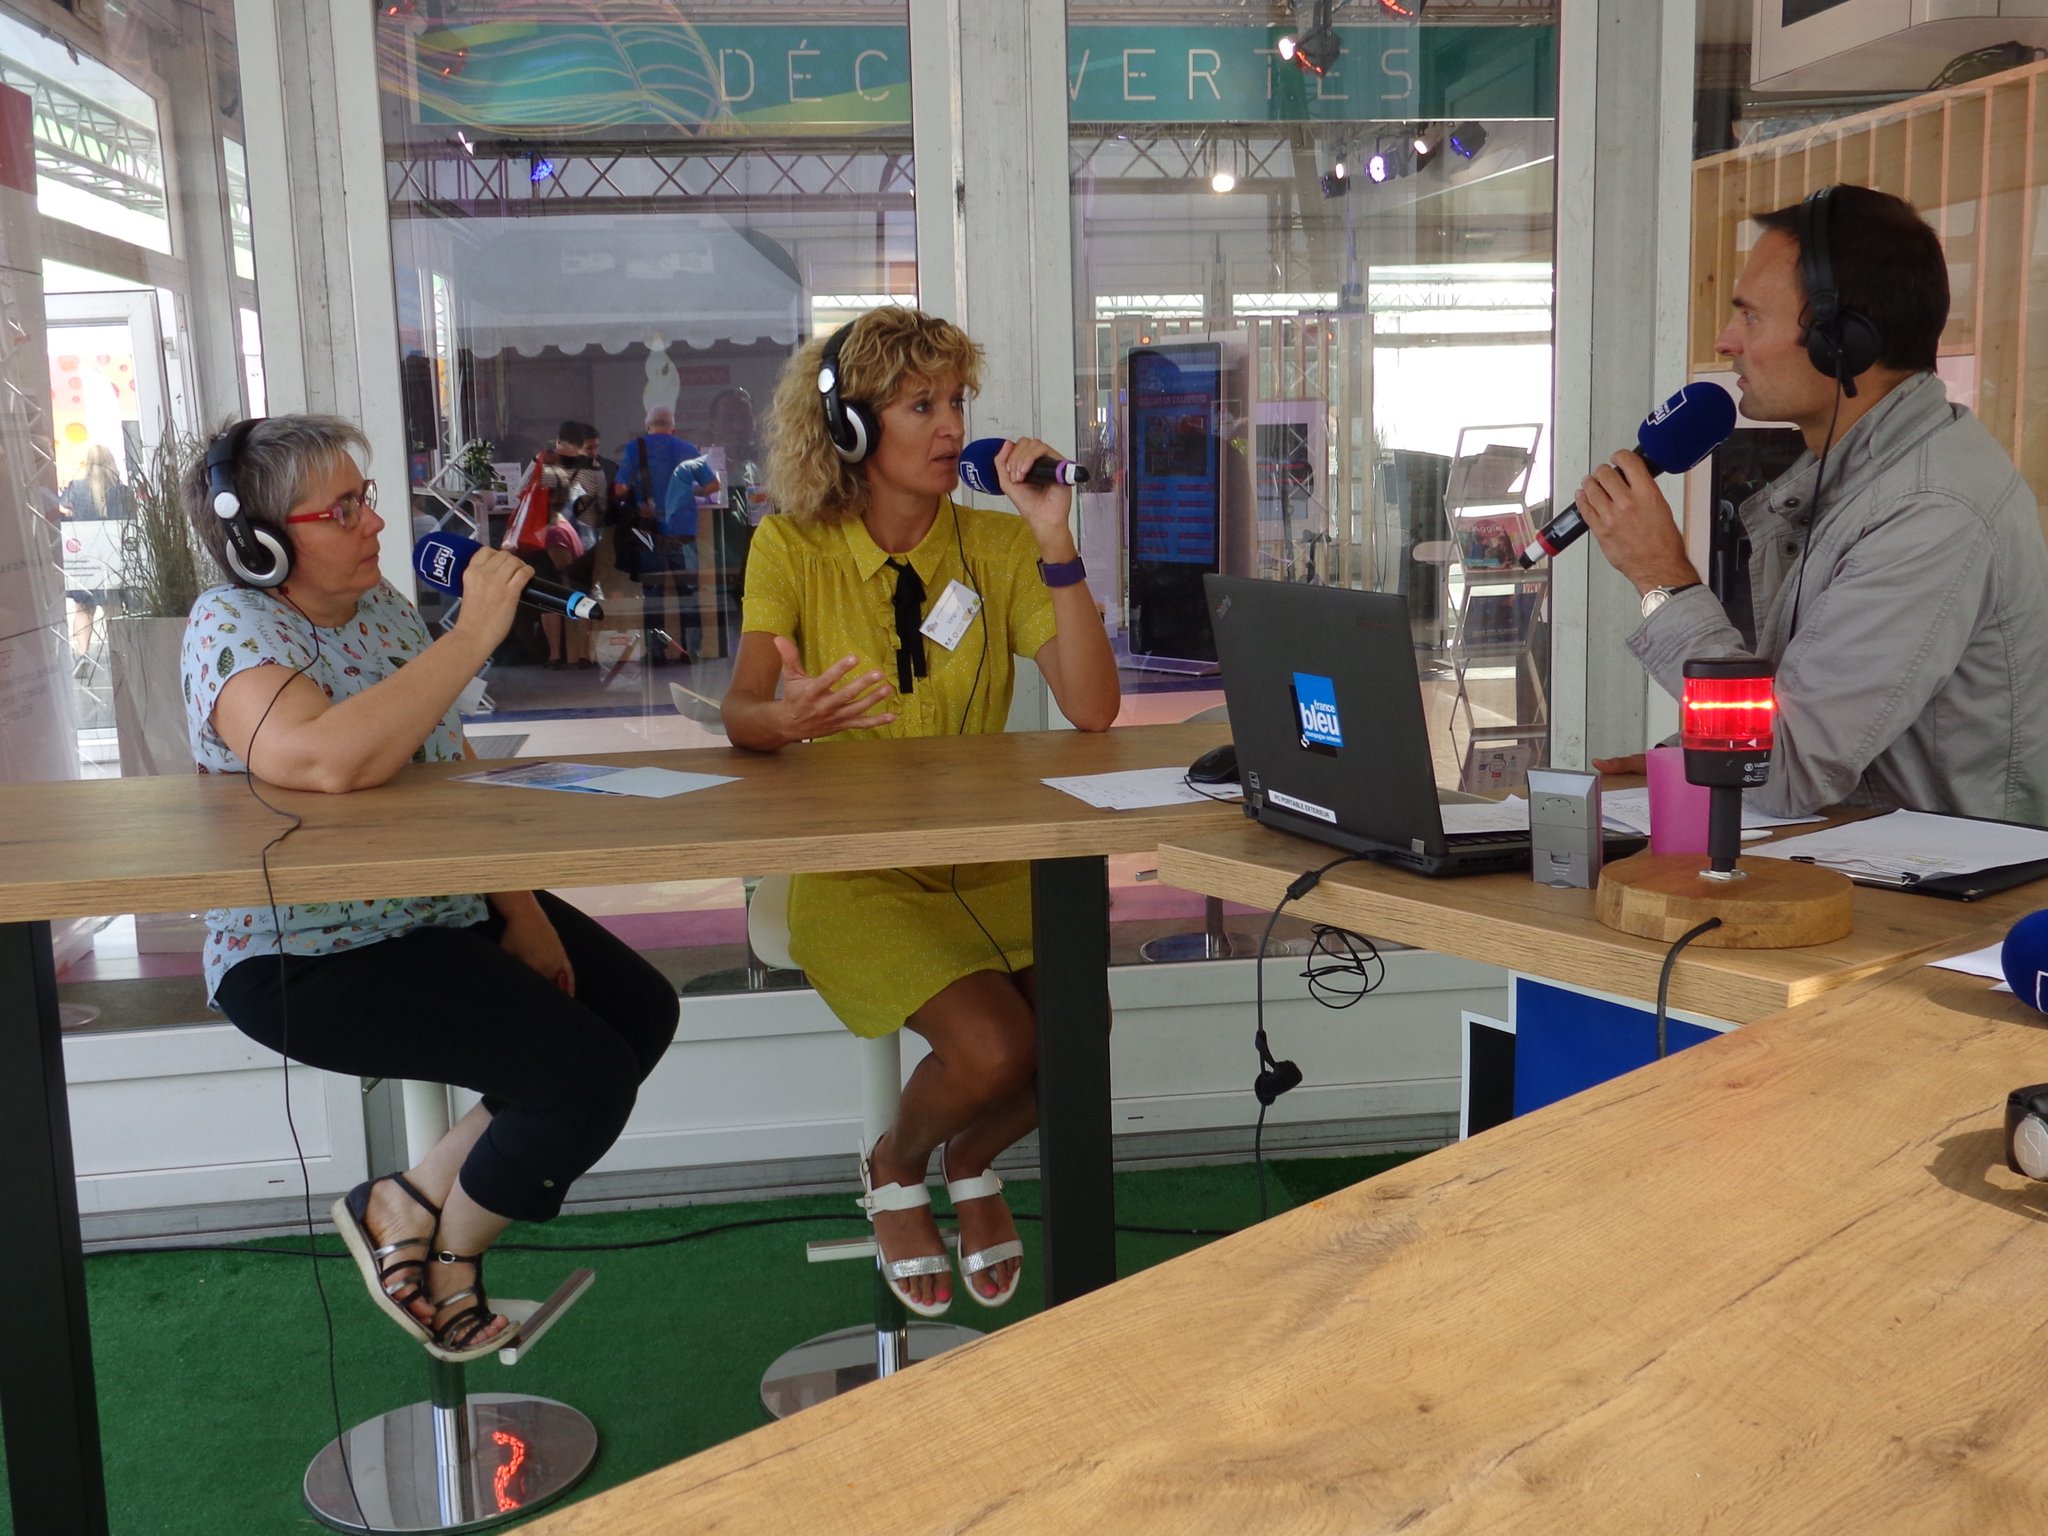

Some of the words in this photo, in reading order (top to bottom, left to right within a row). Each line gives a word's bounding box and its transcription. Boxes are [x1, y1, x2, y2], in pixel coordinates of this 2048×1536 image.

[433, 548, 451, 578] bleu
[1300, 702, 1341, 736] bleu
[1313, 699, 1336, 713] france
[1281, 796, 1304, 810] PORTABLE
[1304, 804, 1330, 818] EXTERIEUR
